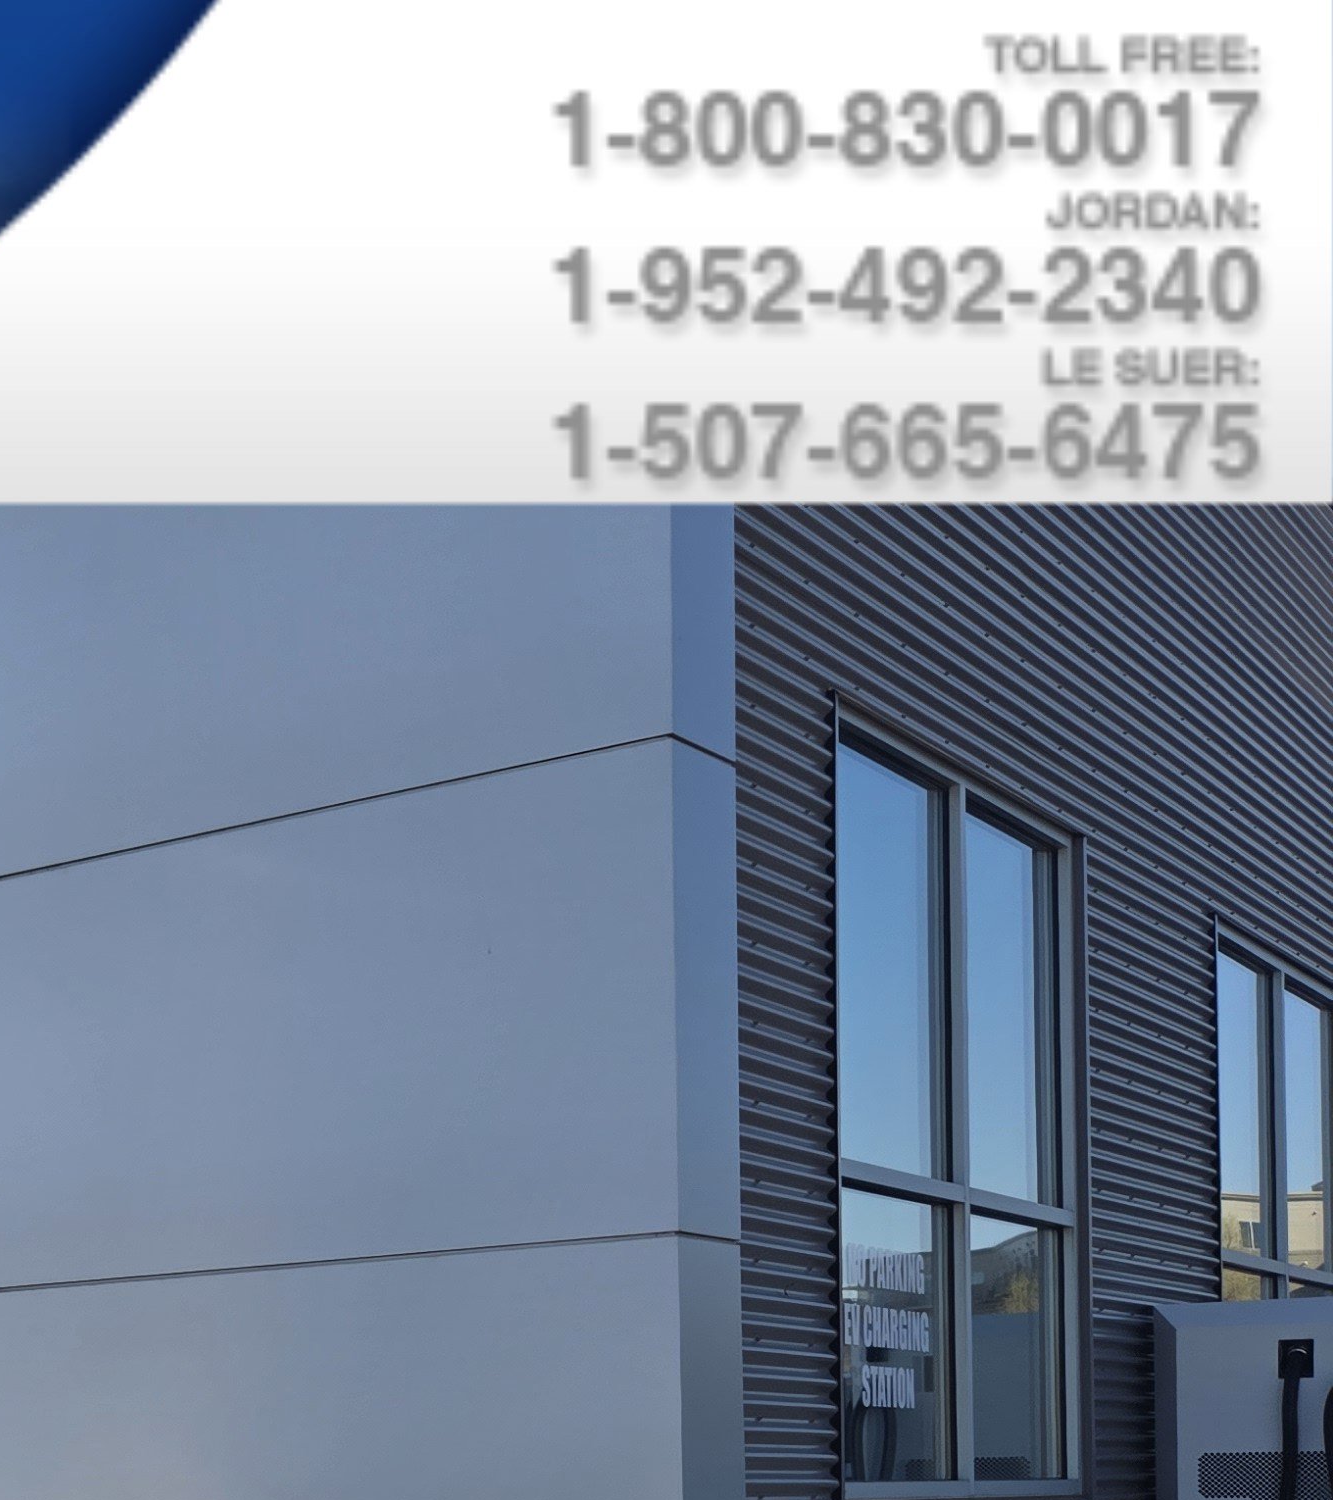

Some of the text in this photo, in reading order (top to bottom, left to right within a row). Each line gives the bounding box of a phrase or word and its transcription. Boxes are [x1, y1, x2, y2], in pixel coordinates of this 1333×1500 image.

[868, 1247, 925, 1295] PARKING
[844, 1302, 930, 1353] EV CHARGING
[862, 1364, 916, 1409] STATION
